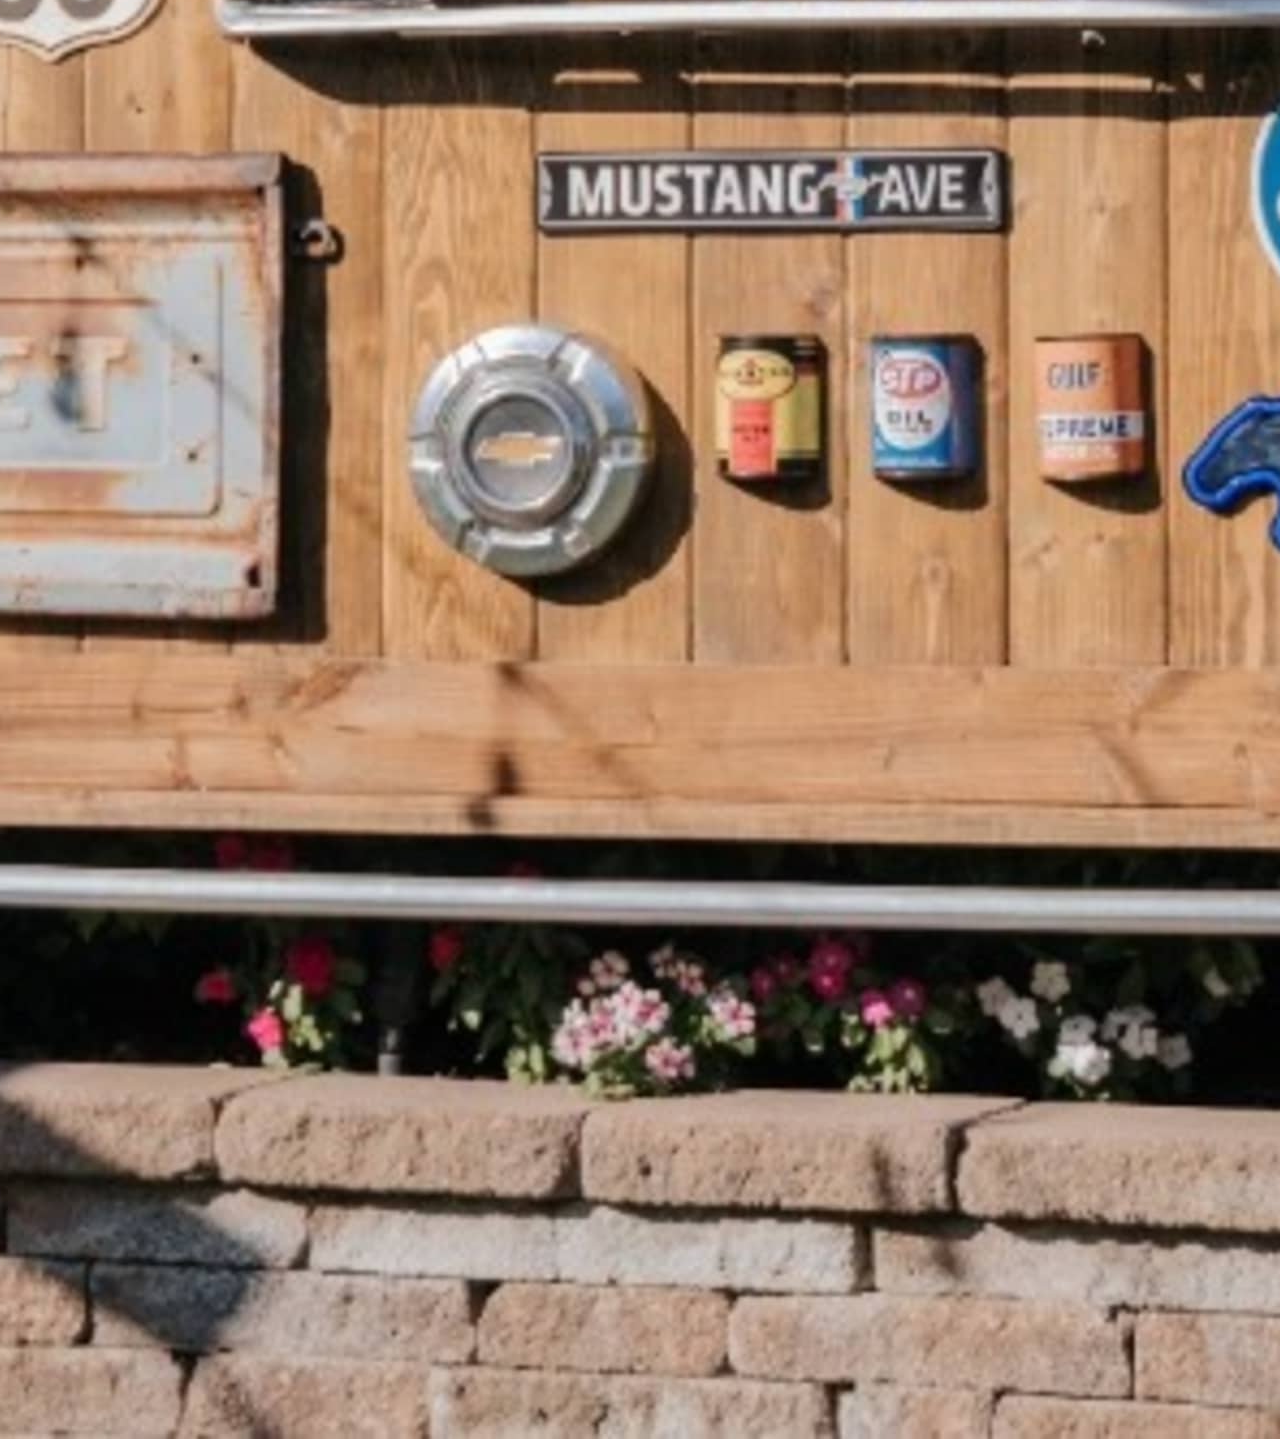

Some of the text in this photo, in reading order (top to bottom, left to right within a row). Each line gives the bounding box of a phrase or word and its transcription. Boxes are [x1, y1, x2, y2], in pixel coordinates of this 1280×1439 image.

[566, 163, 965, 218] MUSTANG AVE
[880, 363, 940, 396] STP
[1047, 362, 1101, 390] GULF
